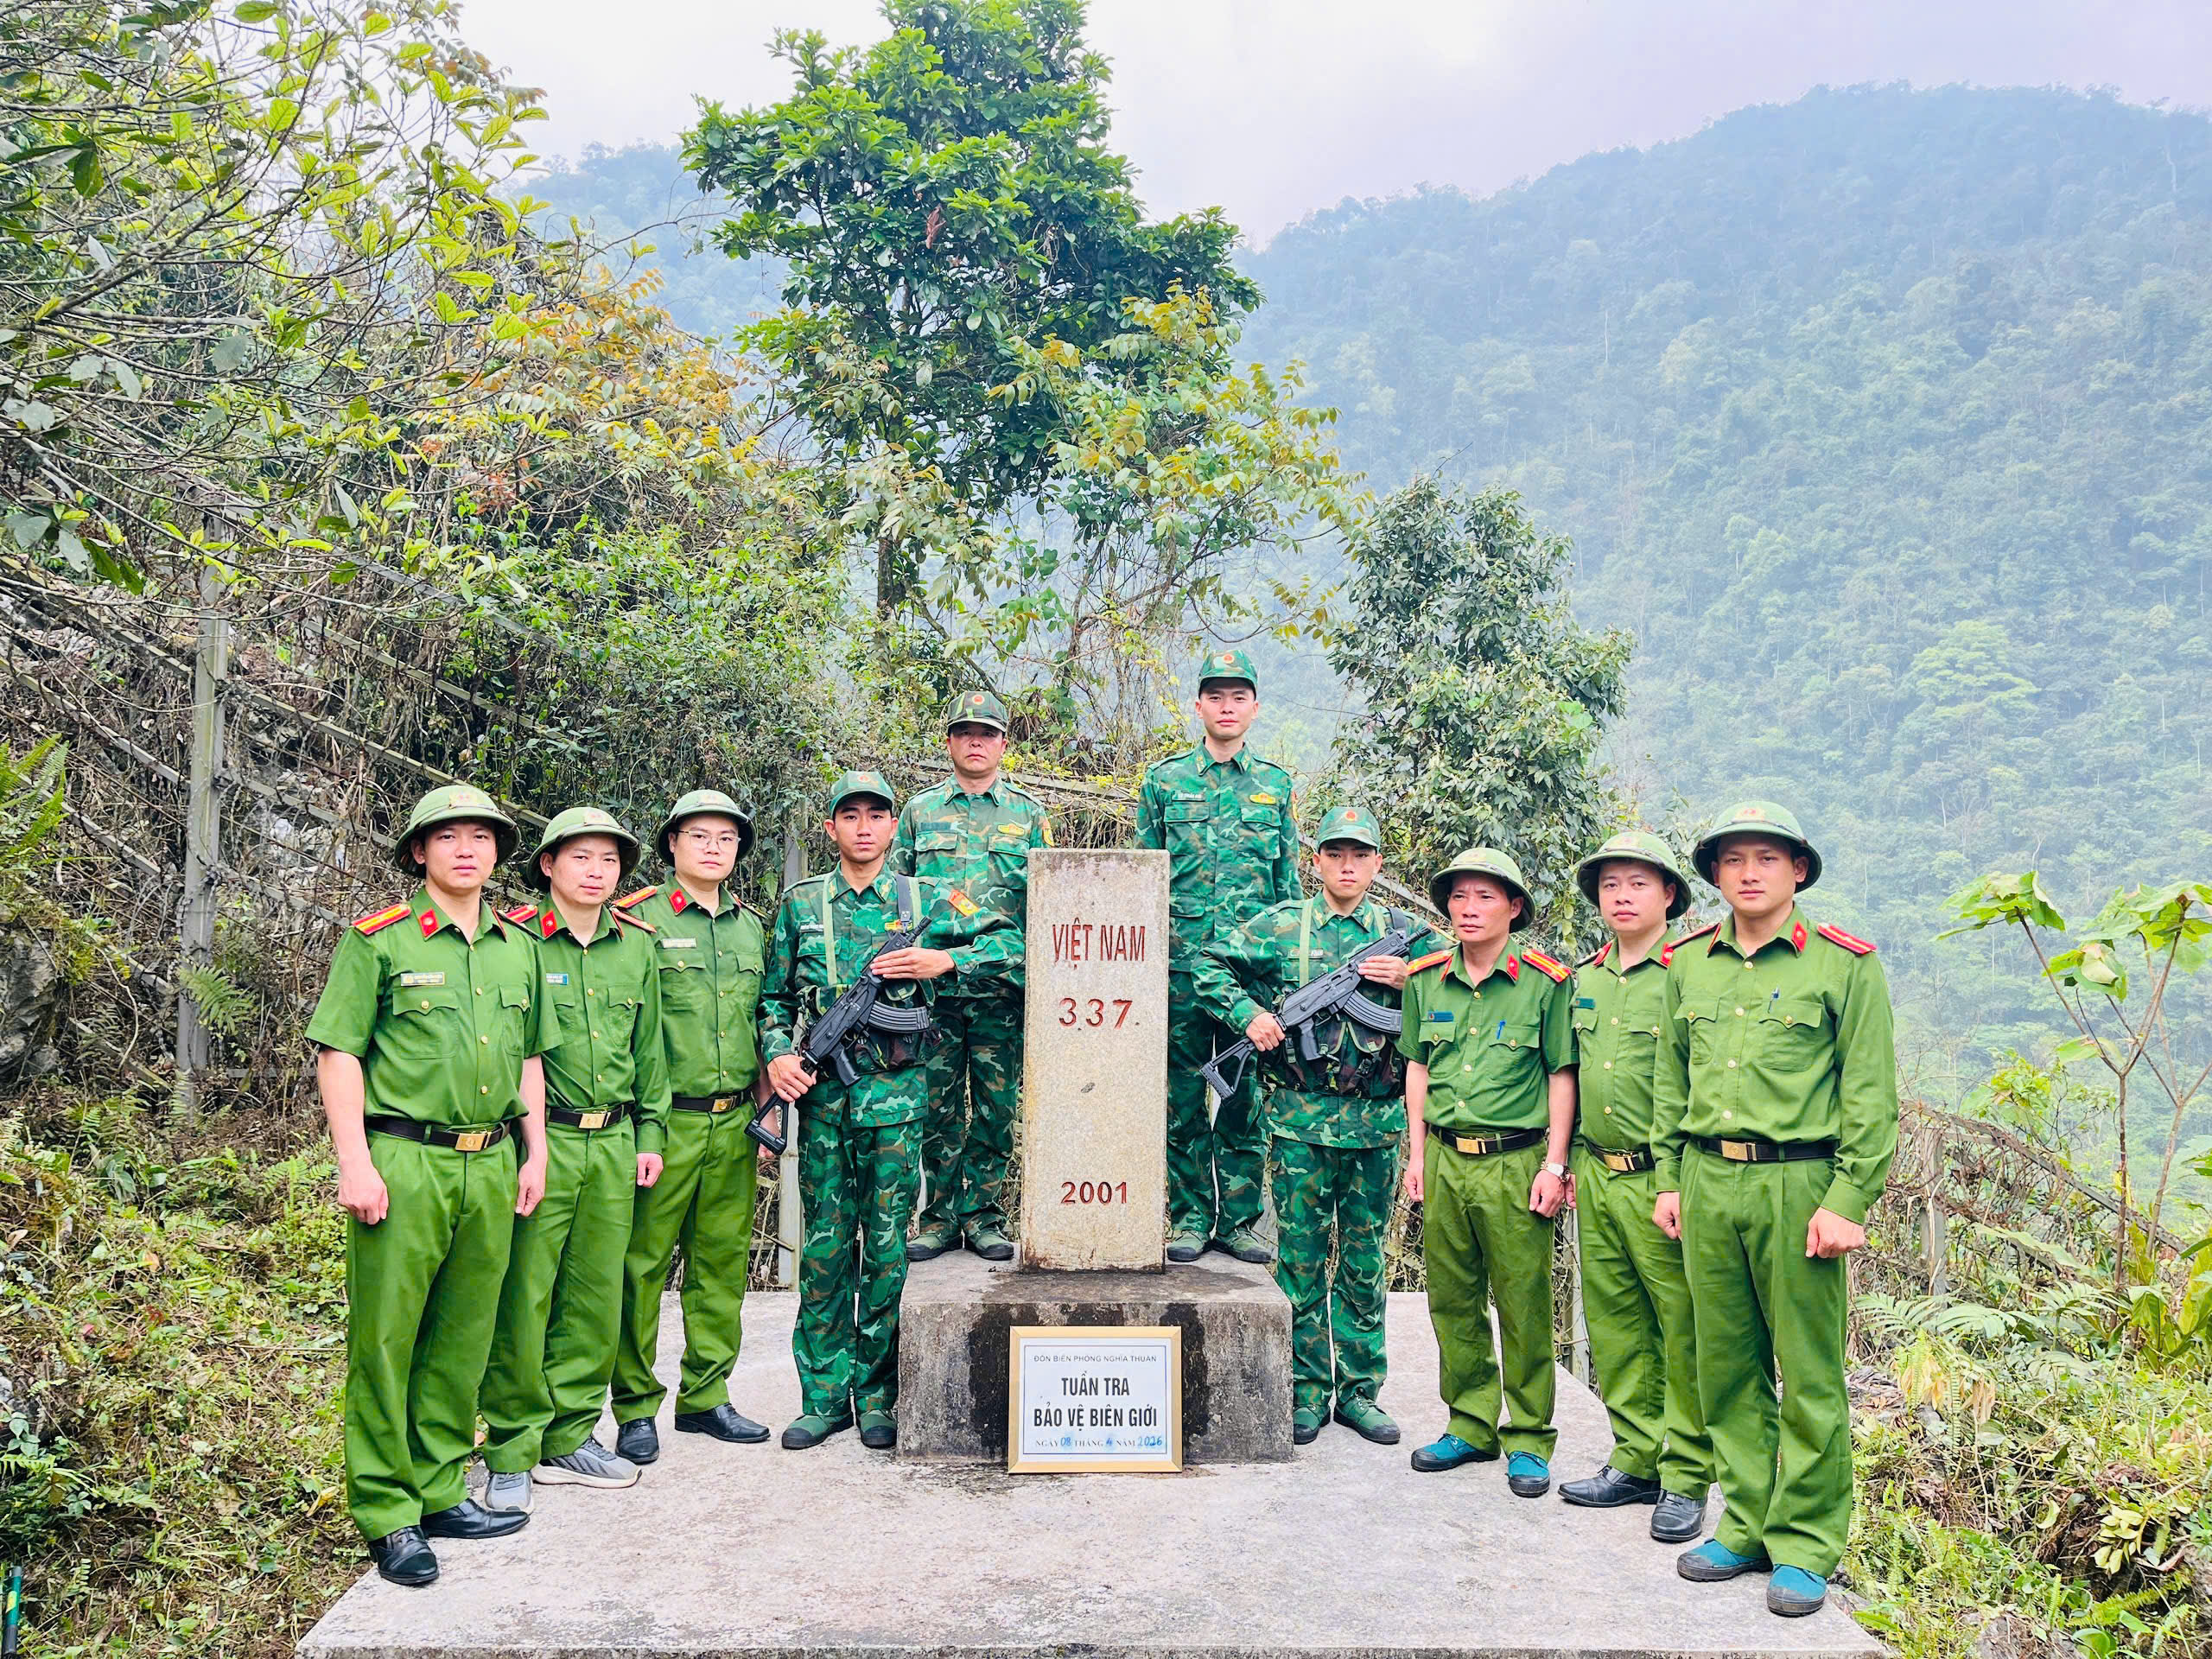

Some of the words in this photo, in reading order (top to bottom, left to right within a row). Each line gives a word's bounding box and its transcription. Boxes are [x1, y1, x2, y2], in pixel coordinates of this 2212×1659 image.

[1052, 917, 1093, 969] VIỆT
[1100, 925, 1146, 962] NAM
[1060, 1181, 1128, 1205] 2001
[1103, 1377, 1130, 1395] TRA
[1033, 1402, 1063, 1427] BẢO
[1068, 1404, 1084, 1431] VỆ
[1090, 1404, 1123, 1427] BIÊN
[1128, 1404, 1157, 1427] GIỚI
